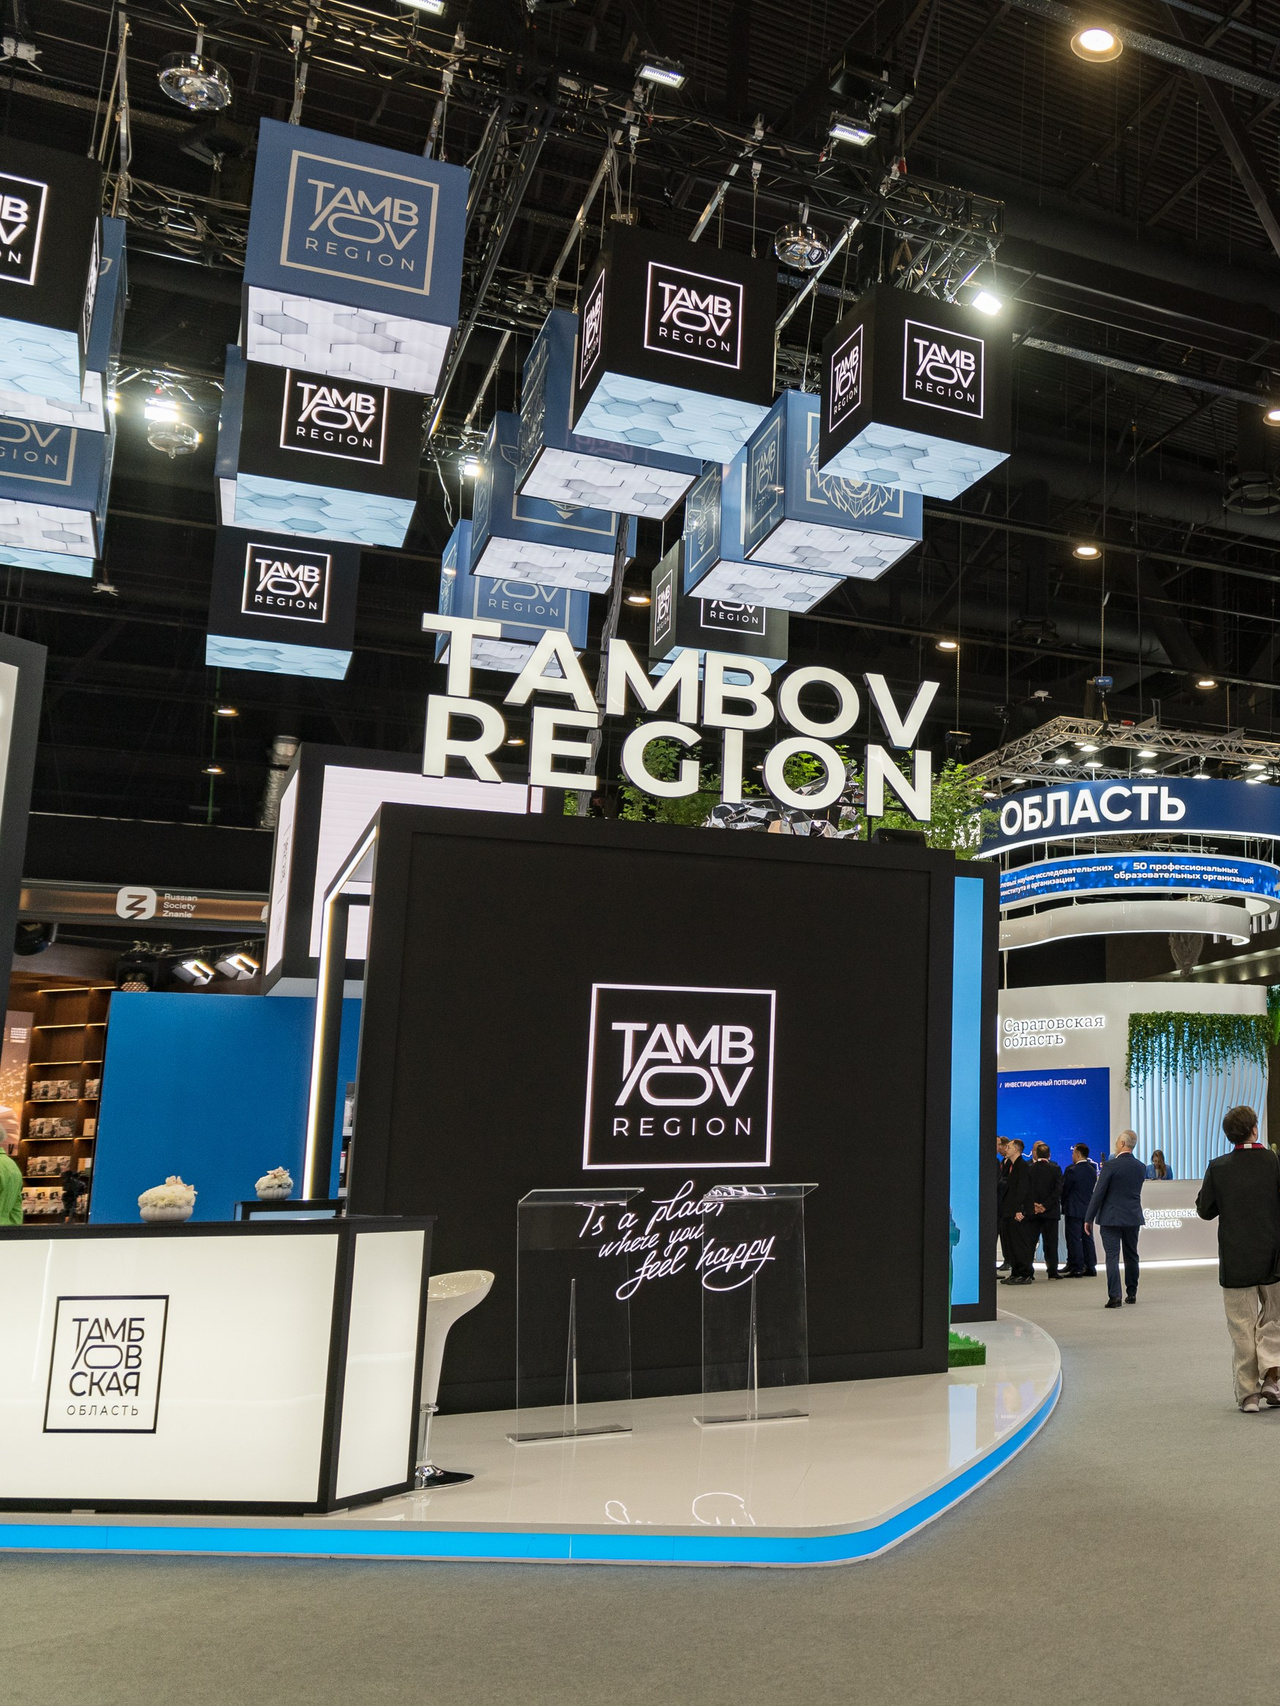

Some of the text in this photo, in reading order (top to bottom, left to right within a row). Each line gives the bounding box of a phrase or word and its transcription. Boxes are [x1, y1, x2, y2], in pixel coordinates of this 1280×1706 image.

[305, 237, 415, 272] REGION
[658, 326, 731, 352] REGION
[915, 380, 975, 403] REGION
[296, 426, 373, 448] REGION
[254, 594, 318, 610] REGION
[488, 598, 559, 617] REGION
[709, 610, 759, 624] REGION
[421, 611, 940, 750] TAMBOV
[422, 694, 933, 822] REGION
[1000, 785, 1187, 836] ОБЛАСТЬ
[1113, 871, 1255, 884] образовательных организаций
[1133, 862, 1239, 874] 50 профессиональных
[163, 902, 196, 911] Society
[164, 893, 198, 901] Russian
[162, 910, 193, 918] Znanie
[1003, 1016, 1104, 1034] Саратовская
[1003, 1034, 1064, 1048] область
[1004, 1079, 1053, 1088] ИНВЕСТИЦИОННЫЙ
[1053, 1078, 1087, 1086] ПОТЕНЦИАЛ
[612, 1117, 751, 1137] REGION
[617, 1211, 639, 1230] a
[598, 1223, 704, 1258] where you
[615, 1236, 776, 1300] feel happy
[68, 1371, 141, 1397] СКАЯ
[66, 1404, 139, 1416] ОБЛАСТЬ
